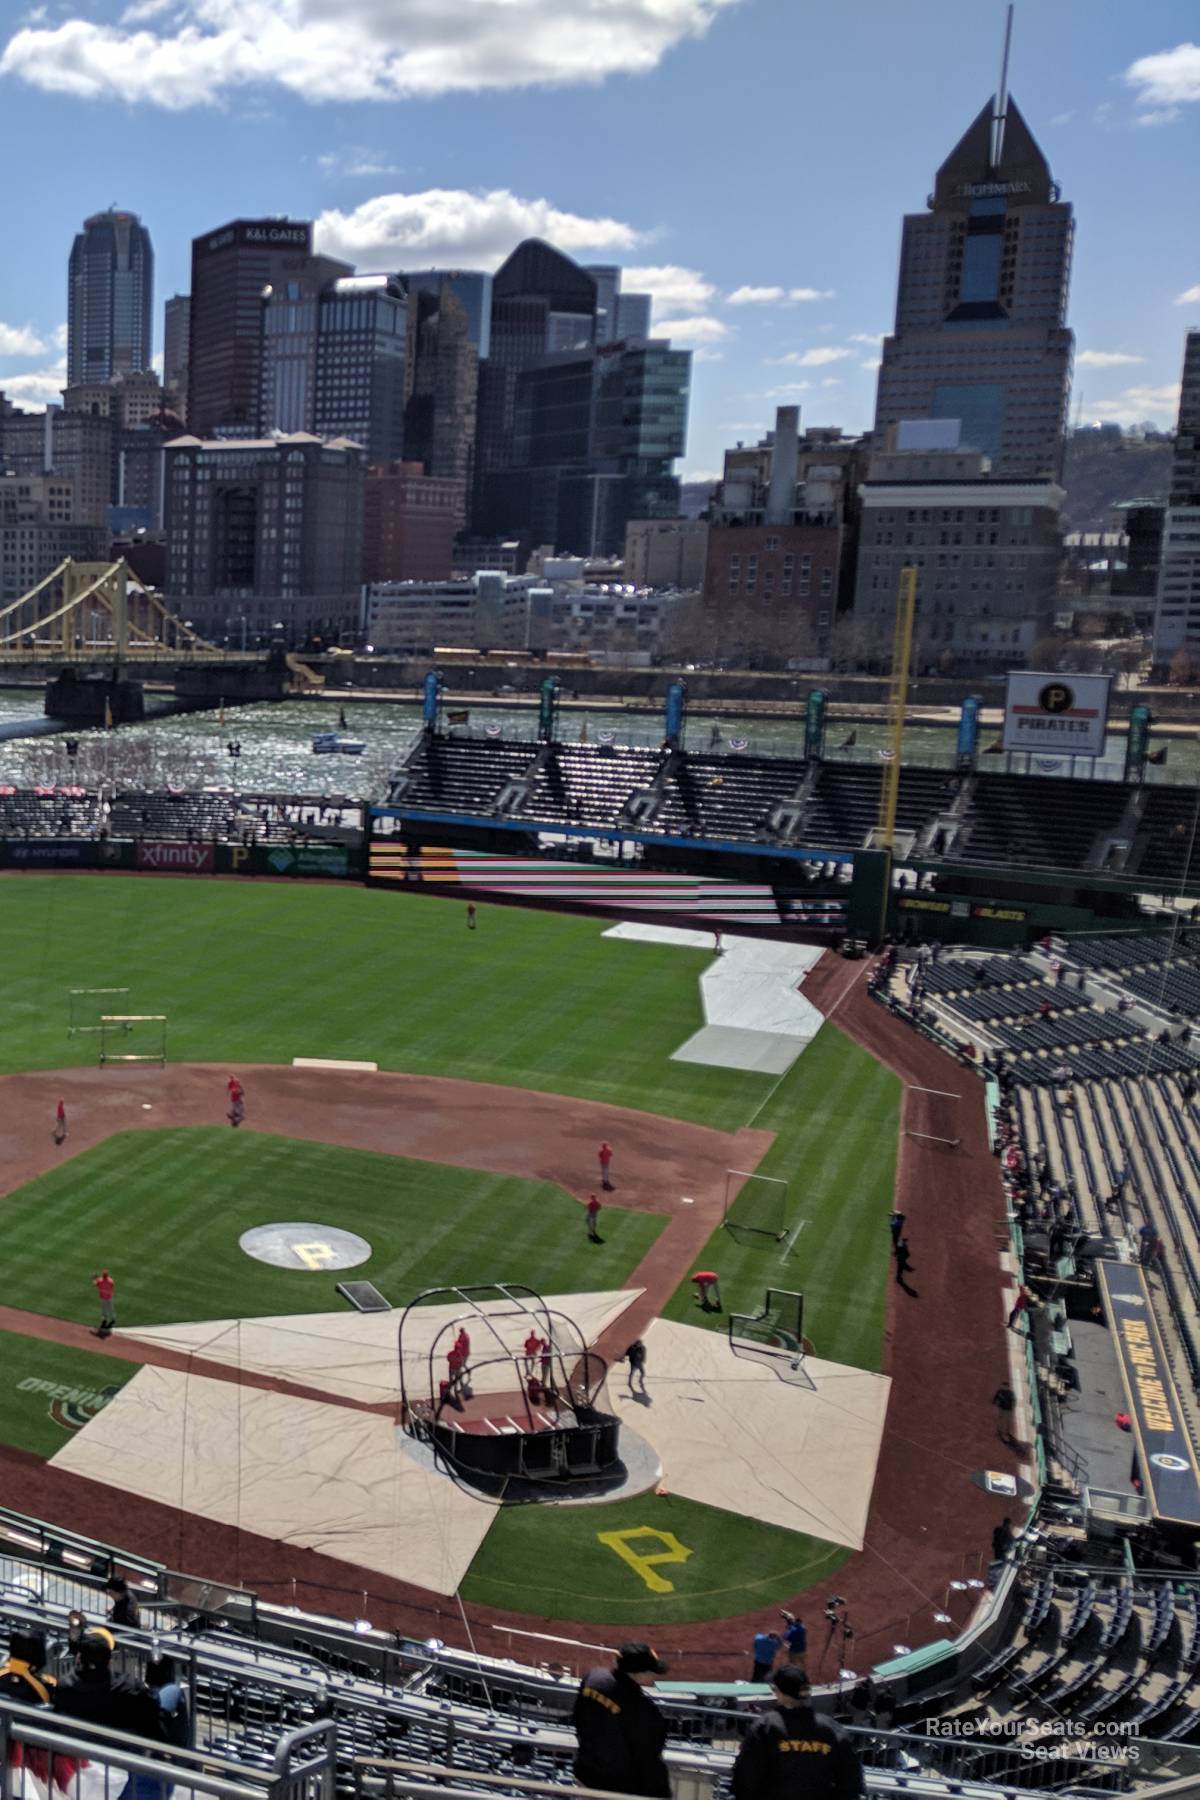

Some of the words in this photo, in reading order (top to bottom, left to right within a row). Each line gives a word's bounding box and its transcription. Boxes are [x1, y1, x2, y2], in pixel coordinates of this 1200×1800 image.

[269, 228, 307, 241] GATES
[1047, 688, 1066, 709] P
[1018, 718, 1090, 733] PIRATES
[30, 847, 80, 857] HYUNDAI
[142, 844, 209, 868] xfinity
[231, 847, 249, 870] P
[291, 1241, 338, 1271] P
[1121, 1318, 1151, 1344] PARK
[1128, 1343, 1157, 1366] PNC
[16, 1376, 114, 1409] OPENIN
[1136, 1377, 1176, 1432] WELCOME
[596, 1525, 694, 1594] P
[777, 1738, 833, 1757] STAFF
